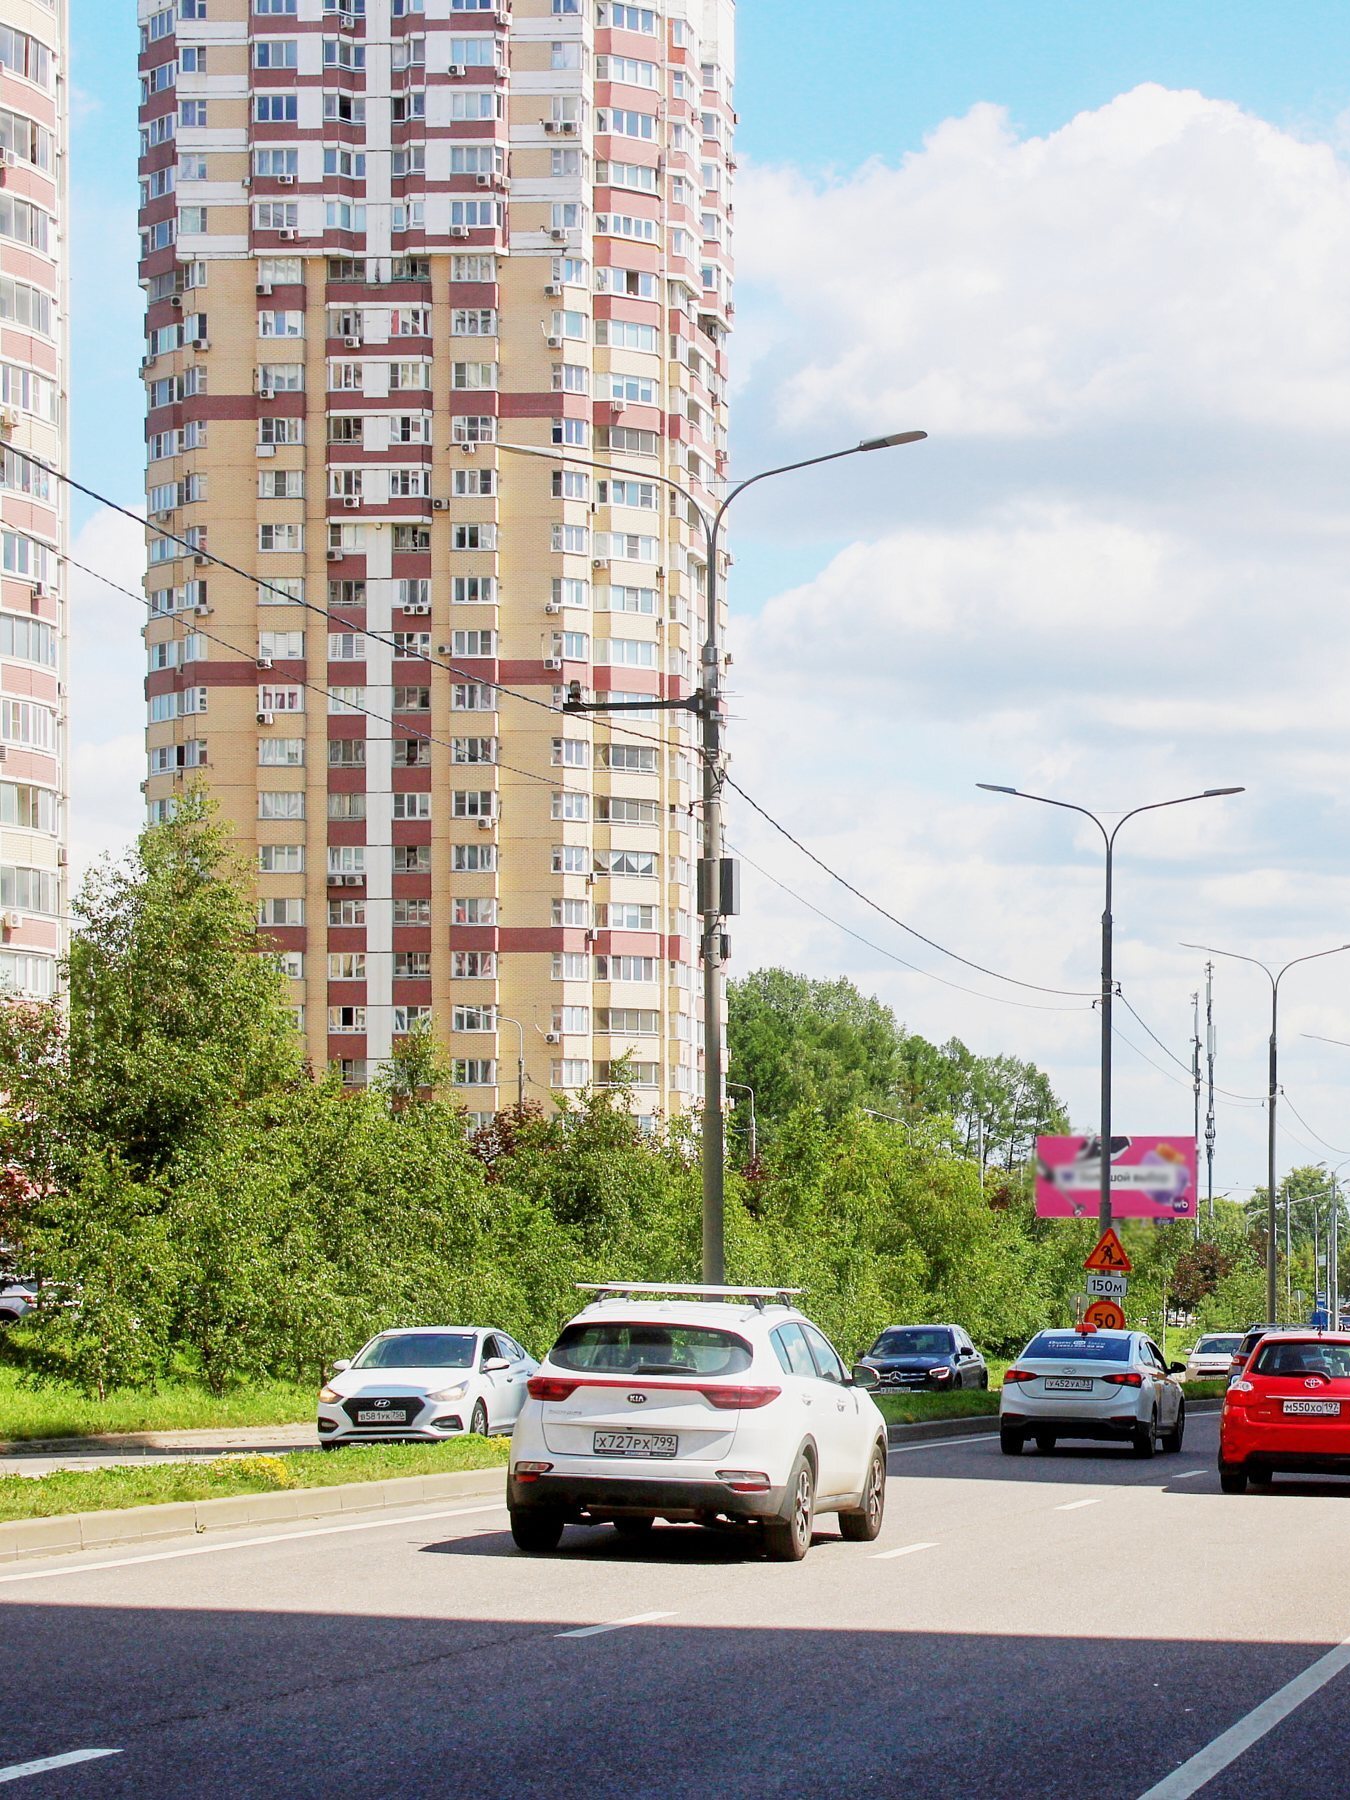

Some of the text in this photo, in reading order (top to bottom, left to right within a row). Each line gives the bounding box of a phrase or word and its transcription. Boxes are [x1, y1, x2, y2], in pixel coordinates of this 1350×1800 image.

[1094, 1313, 1115, 1329] 50
[1285, 1402, 1322, 1412] М550ХО
[599, 1435, 672, 1449] Х727РХ 799
